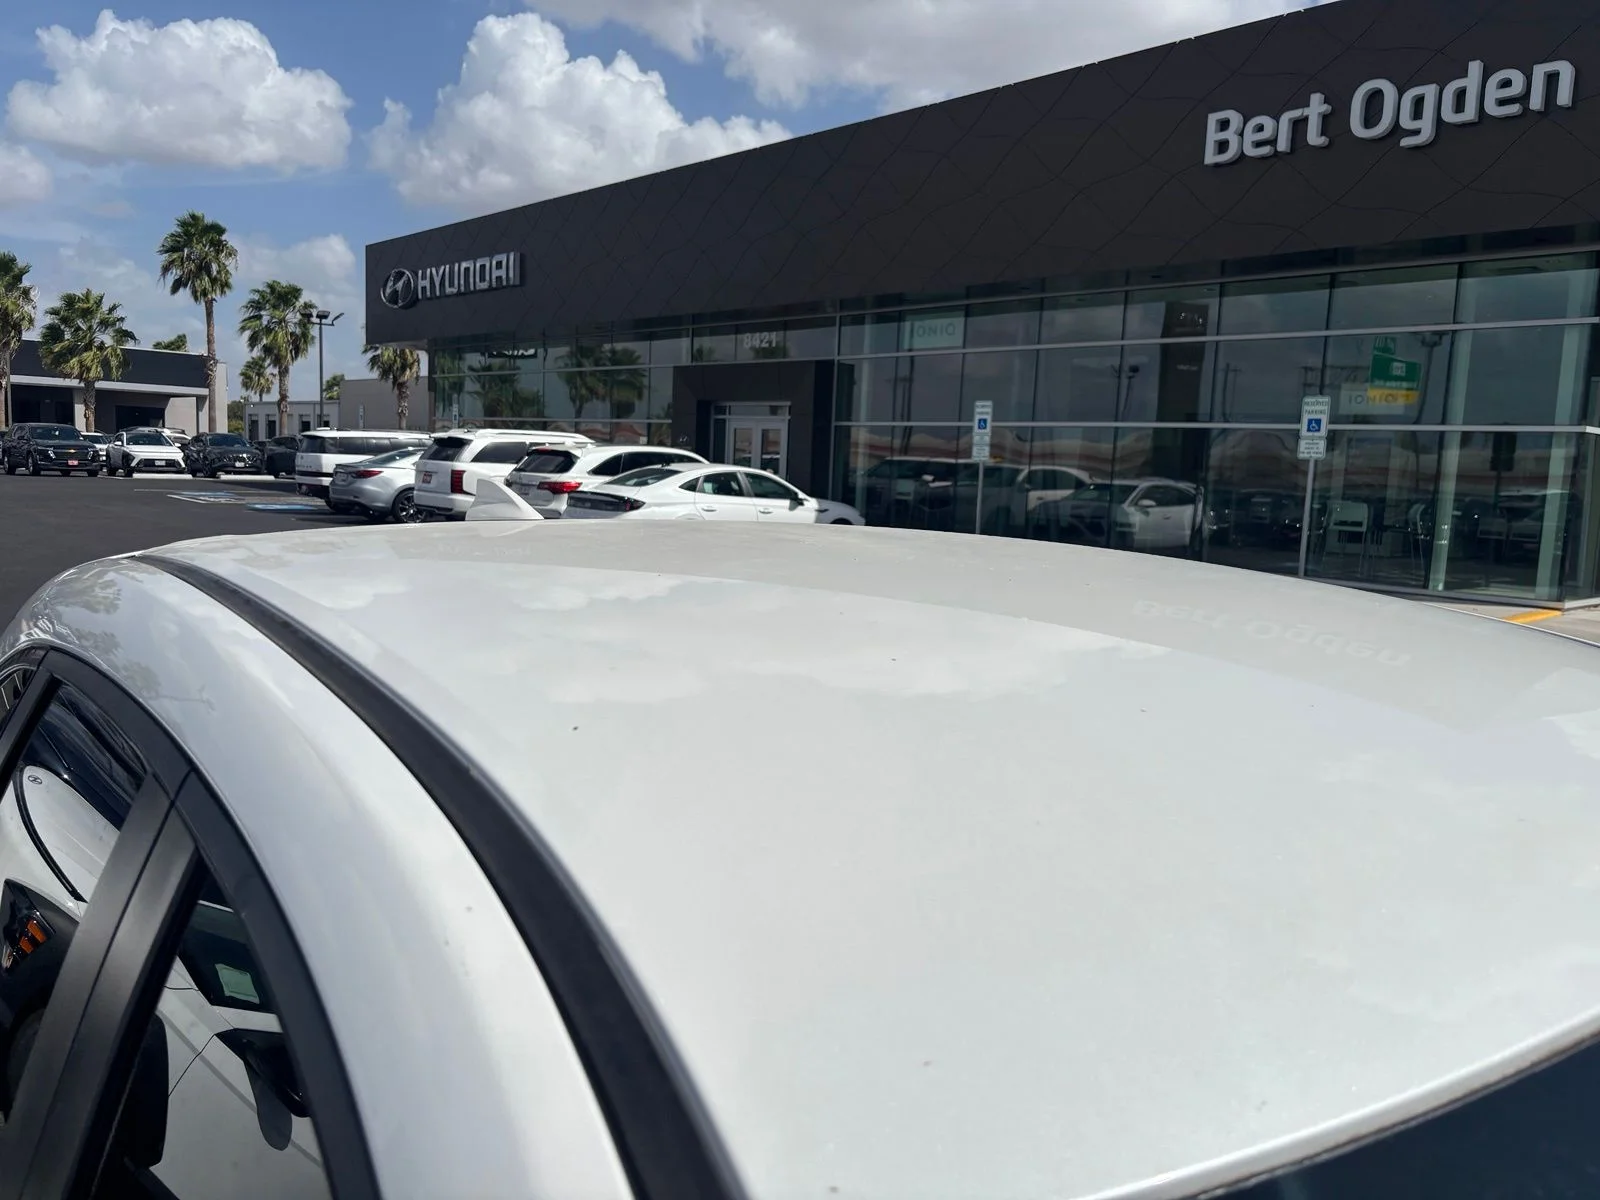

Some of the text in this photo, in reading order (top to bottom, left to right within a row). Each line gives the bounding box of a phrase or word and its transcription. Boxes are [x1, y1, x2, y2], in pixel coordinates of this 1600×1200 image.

[1203, 59, 1576, 166] Bert Ogden
[418, 252, 520, 300] HYUNDAI
[743, 331, 777, 348] 8421
